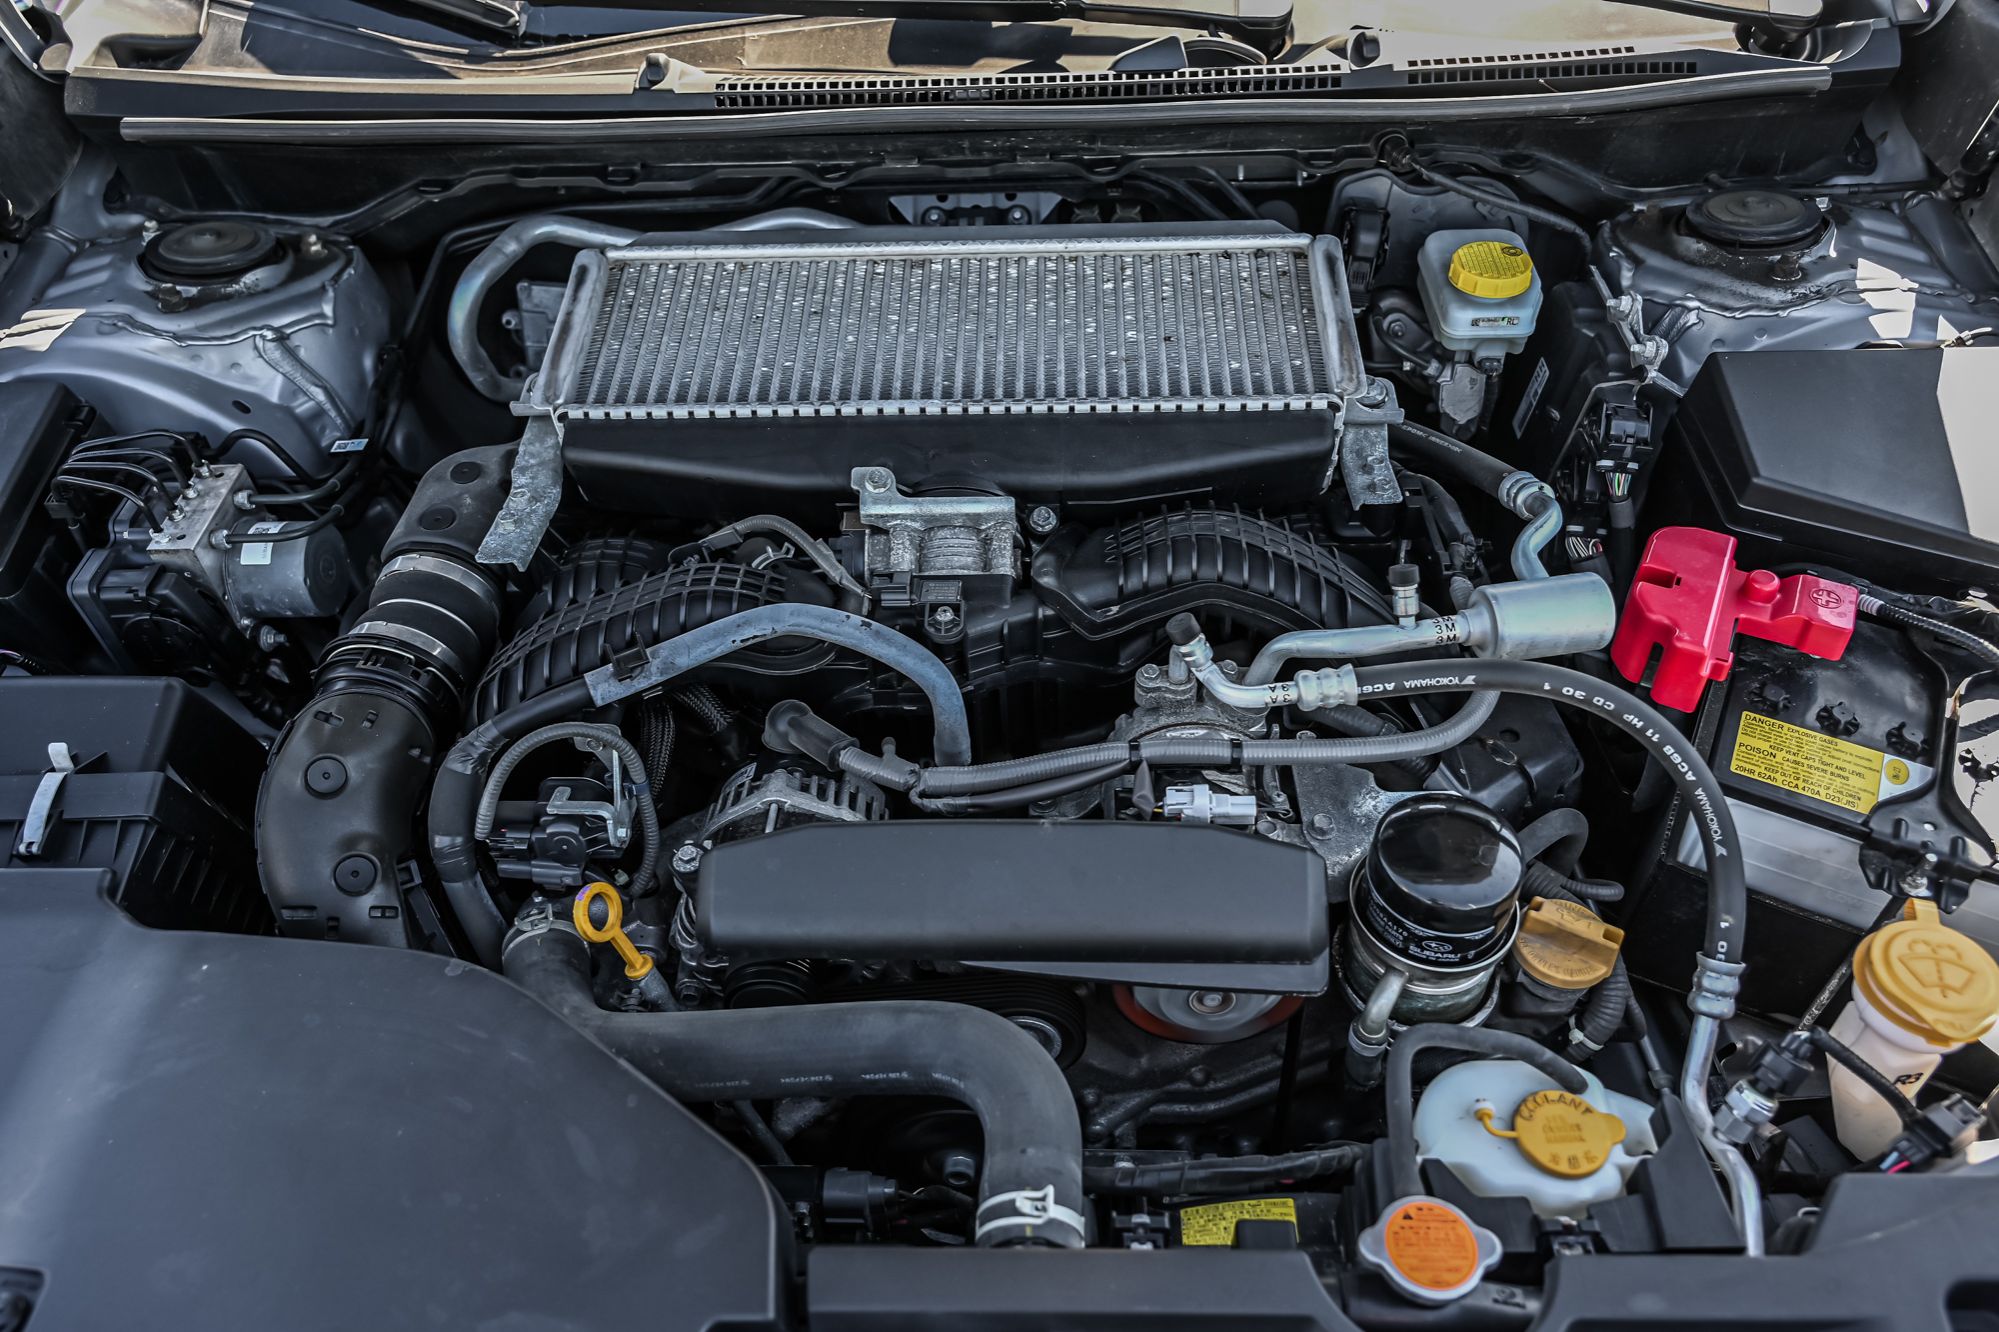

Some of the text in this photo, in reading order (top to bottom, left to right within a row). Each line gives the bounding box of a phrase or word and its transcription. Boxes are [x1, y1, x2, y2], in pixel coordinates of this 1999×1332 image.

[1434, 622, 1456, 635] 3M
[1403, 676, 1460, 689] YOKOHAMA
[1561, 686, 1586, 700] 30
[1592, 696, 1616, 711] CD
[1622, 713, 1645, 729] HP
[1744, 713, 1784, 731] DANGER
[1786, 726, 1817, 740] EXPLOSIVE
[1645, 728, 1660, 742] 11
[1738, 741, 1776, 759] POISON
[1781, 755, 1805, 767] CAUSES
[1805, 763, 1828, 774] SEVERE
[1829, 770, 1849, 781] BURNS
[1768, 743, 1784, 753] KEEP
[1784, 748, 1799, 757] VENT
[1800, 753, 1816, 763] CAPS
[1817, 758, 1833, 768] TIGHT
[1834, 764, 1847, 773] AND
[1734, 763, 1755, 775] 20HR
[1757, 770, 1777, 783] 62Ah
[1781, 778, 1799, 790] CCA
[1800, 784, 1821, 796] 470A
[1763, 766, 1779, 775] KEEP
[1779, 771, 1791, 779] OUT
[1694, 787, 1723, 841] YOKOHAMA
[1409, 945, 1461, 960] SUBARU
[1520, 1093, 1595, 1122] COOLANT
